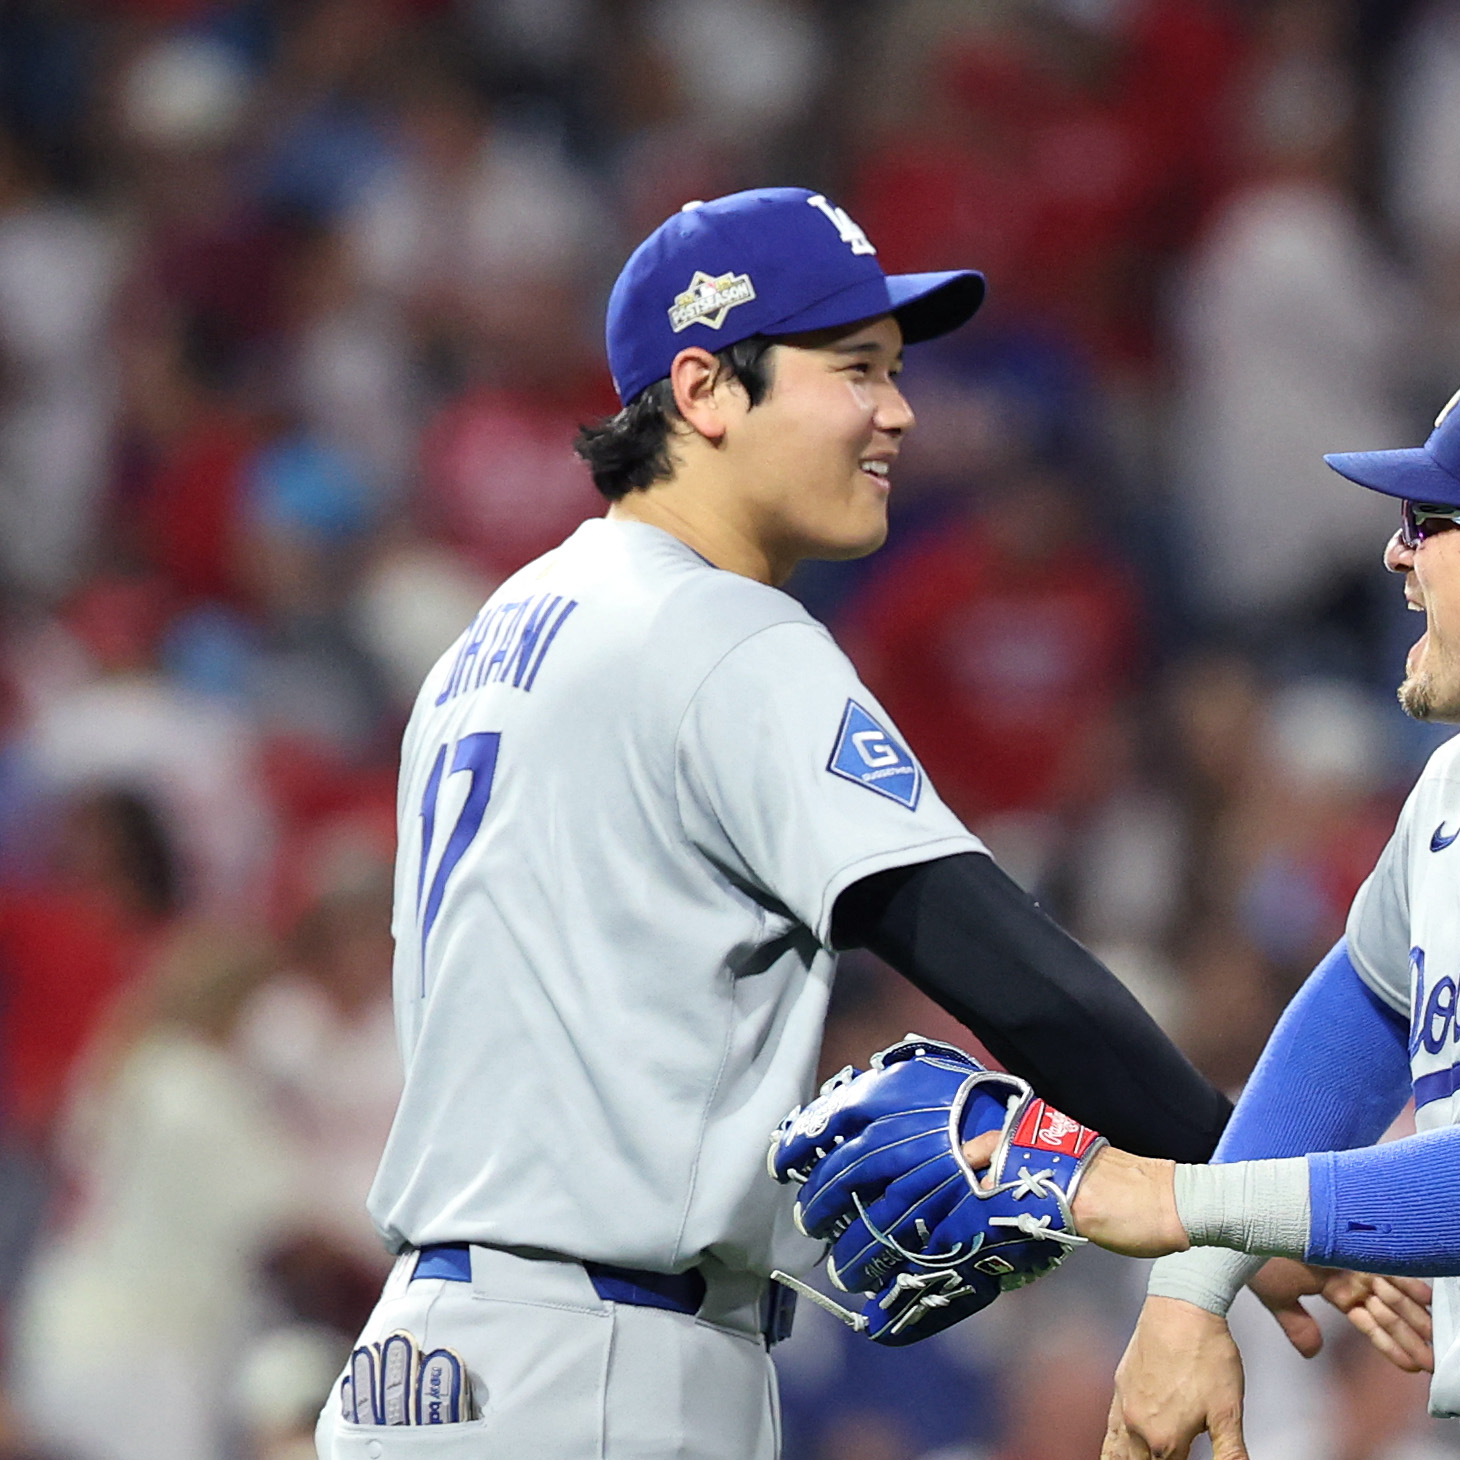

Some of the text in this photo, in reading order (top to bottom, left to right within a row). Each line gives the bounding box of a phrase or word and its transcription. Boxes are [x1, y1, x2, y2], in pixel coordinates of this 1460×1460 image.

[671, 283, 749, 324] POSTSEASON
[851, 730, 899, 769] G
[416, 731, 502, 998] 17
